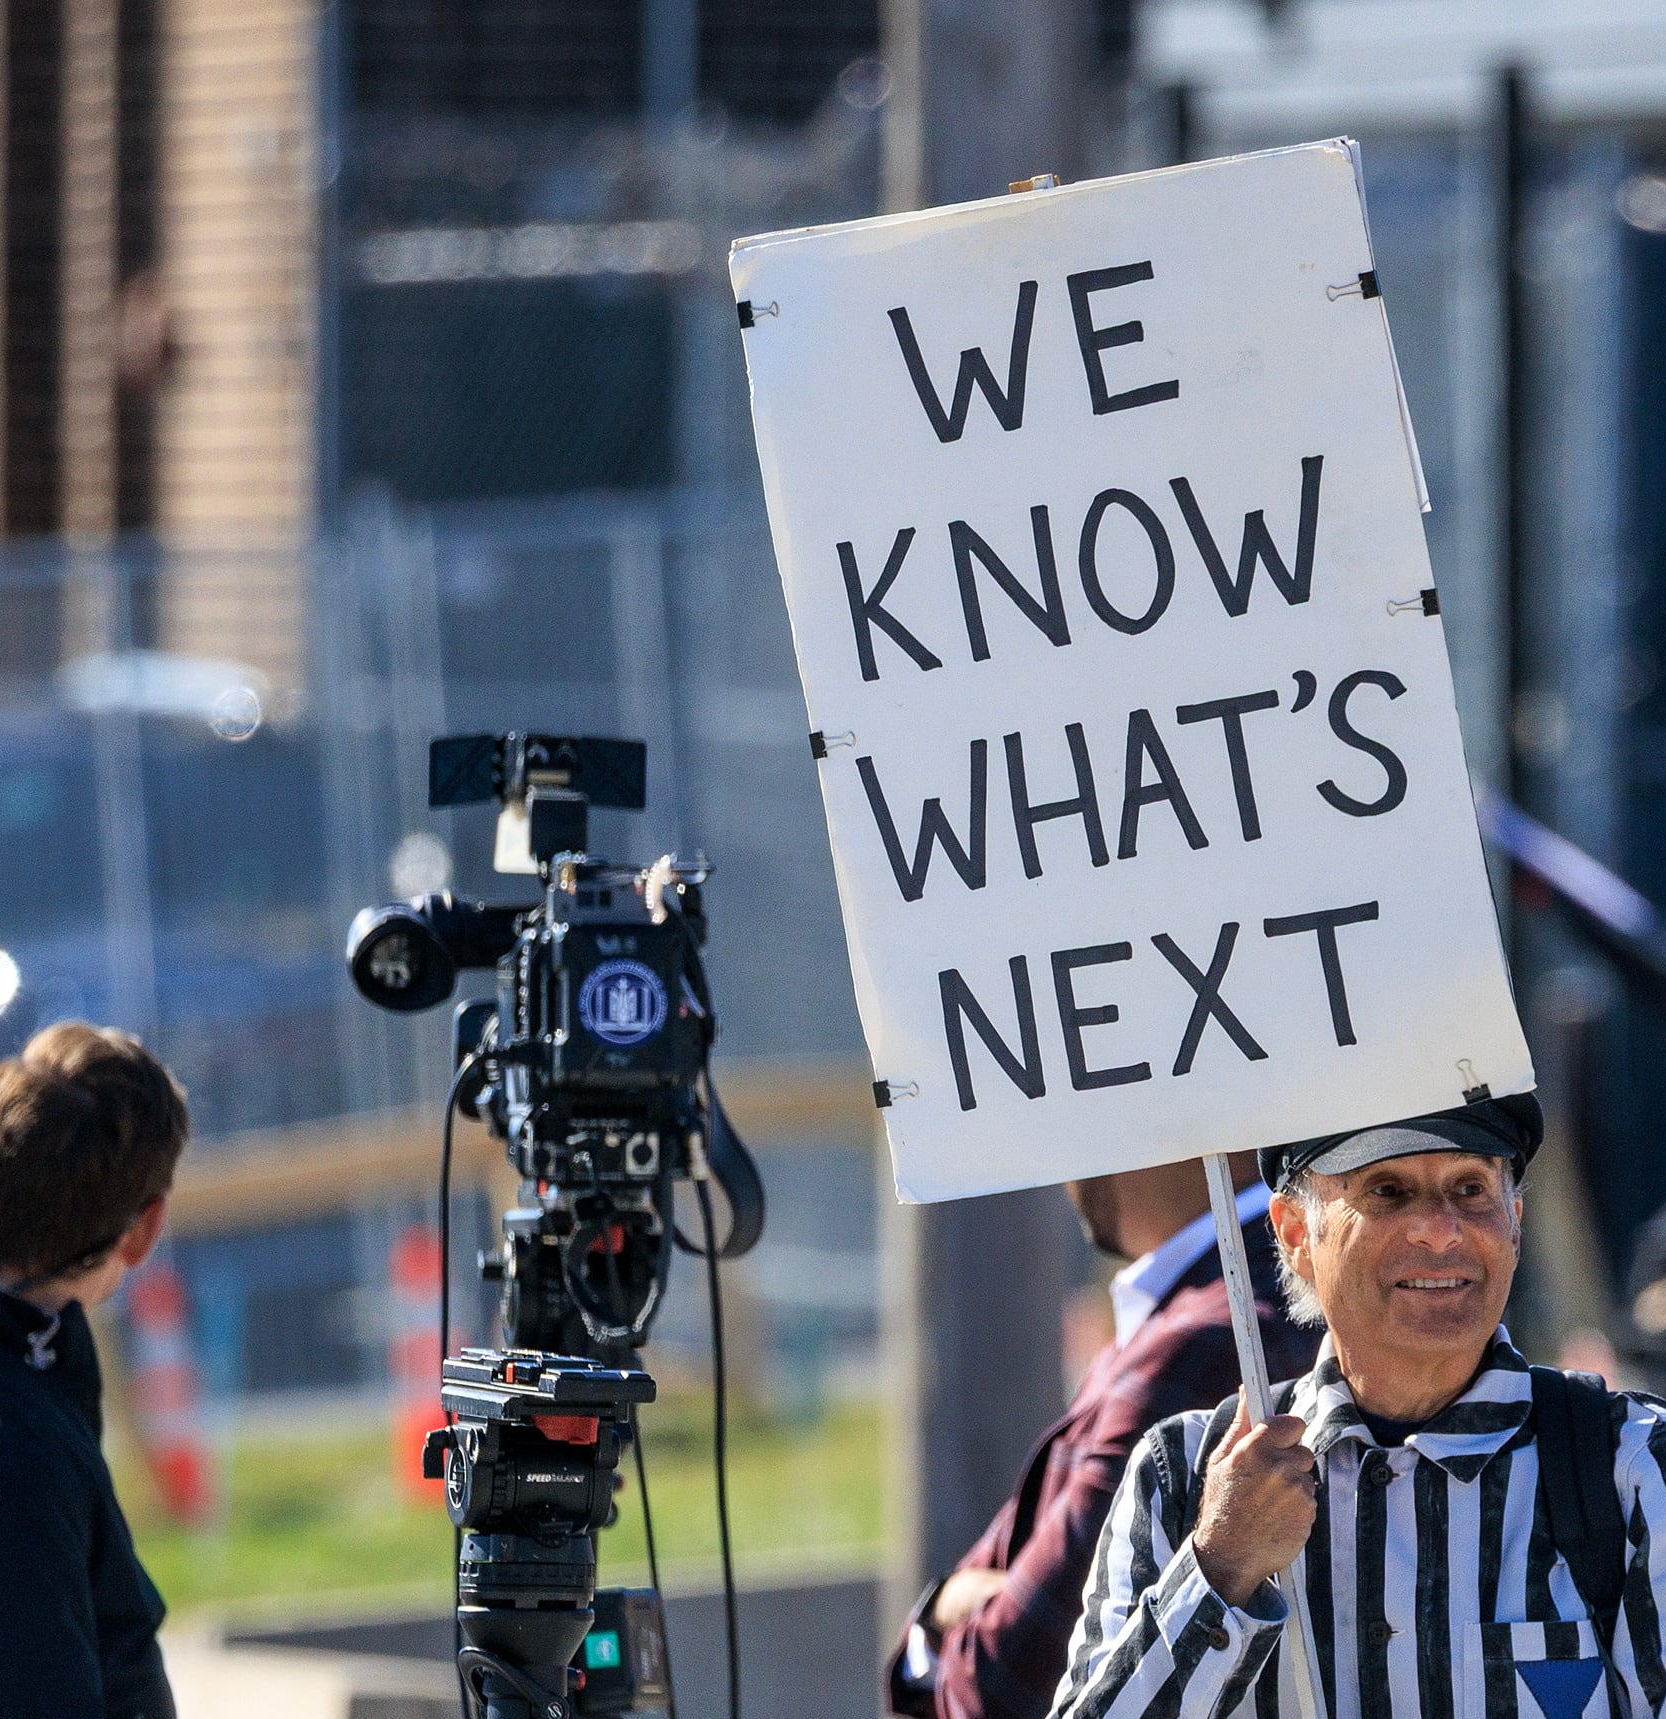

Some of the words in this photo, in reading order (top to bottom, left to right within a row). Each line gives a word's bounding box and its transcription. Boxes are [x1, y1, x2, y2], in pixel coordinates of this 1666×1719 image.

[887, 261, 1180, 444] WE
[836, 455, 1324, 682] KNOW
[855, 669, 1408, 903] WHAT'S
[939, 900, 1379, 1111] NEXT
